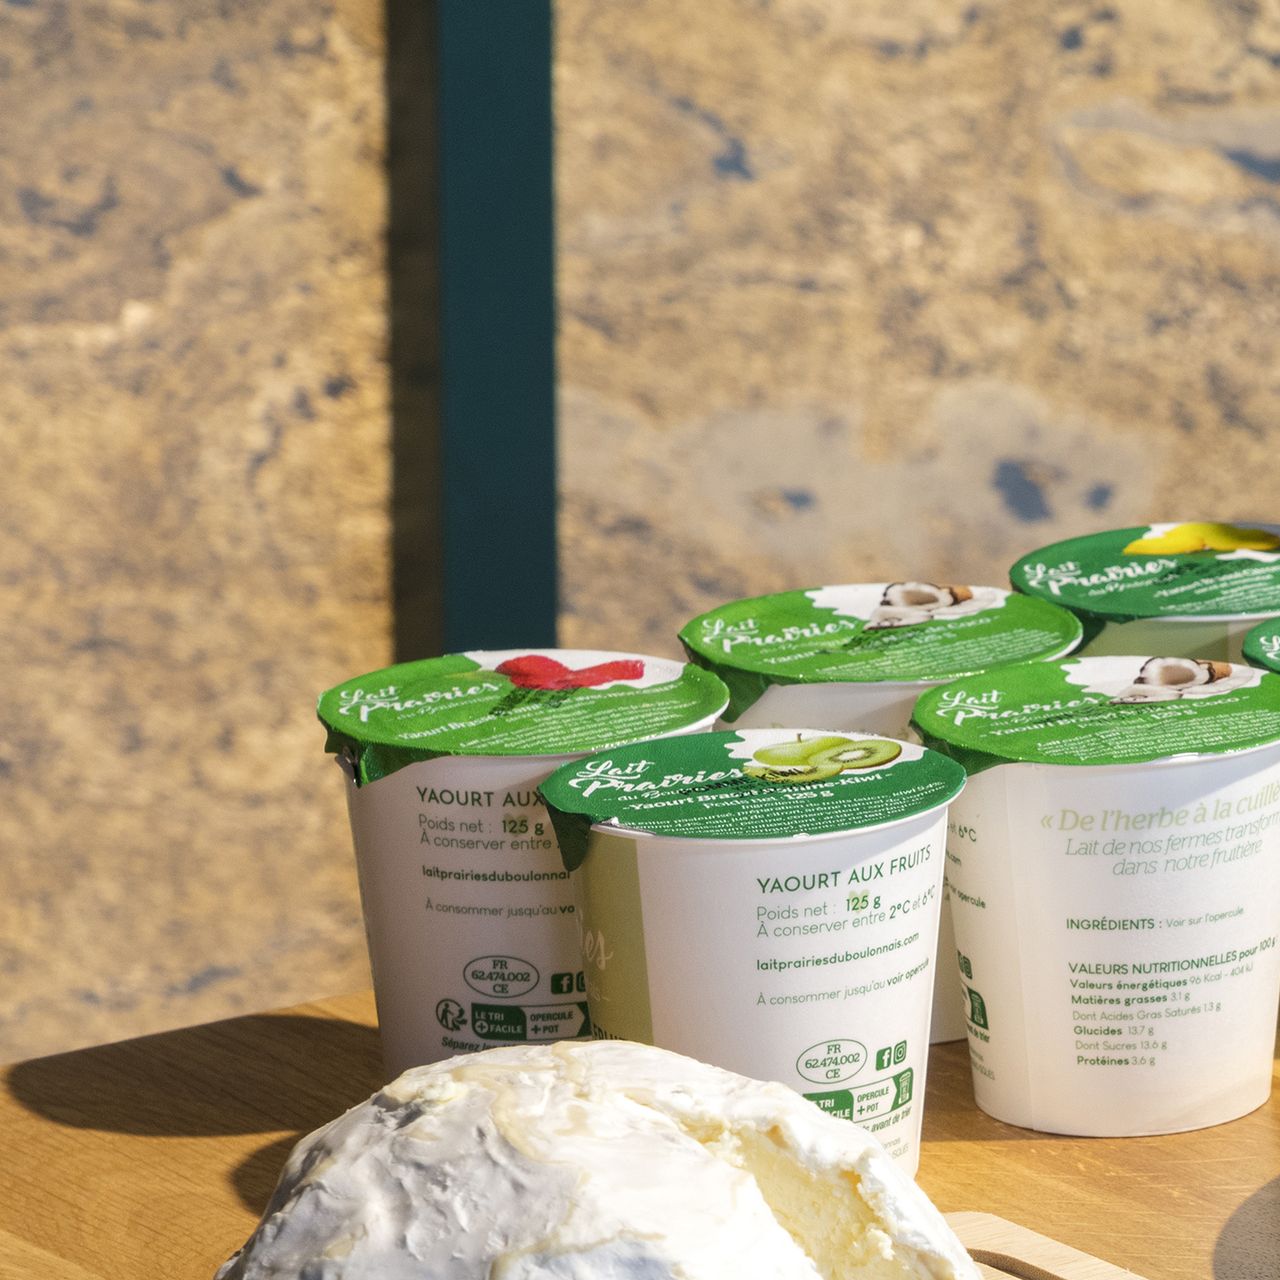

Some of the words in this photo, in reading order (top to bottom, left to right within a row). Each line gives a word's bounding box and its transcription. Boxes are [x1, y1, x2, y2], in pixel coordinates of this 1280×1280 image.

[937, 688, 1008, 710] Lait
[578, 759, 655, 779] Lait
[569, 766, 746, 798] Prairies
[416, 786, 494, 808] YAOURT
[502, 791, 545, 808] AUX
[418, 813, 456, 832] Poids
[460, 819, 484, 833] net
[502, 819, 530, 835] 125
[535, 822, 545, 837] g
[1058, 809, 1095, 832] De
[1193, 803, 1208, 824] à
[1212, 798, 1232, 821] la
[420, 828, 431, 846] À
[434, 836, 505, 851] conserver
[510, 837, 552, 851] entre
[1065, 837, 1100, 856] Lait
[1102, 838, 1125, 856] de
[1129, 838, 1162, 854] nos
[1162, 827, 1222, 856] fermes
[756, 870, 842, 894] YAOURT
[847, 861, 885, 885] AUX
[889, 843, 932, 876] FRUITS
[1112, 858, 1158, 877] dans
[1163, 851, 1209, 873] notre
[424, 896, 434, 912] À
[435, 903, 504, 917] consommer
[756, 904, 799, 921] Poids
[803, 901, 828, 917] net
[845, 894, 869, 912] 125
[872, 895, 882, 910] g
[756, 920, 769, 939] À
[772, 918, 849, 939] conserver
[852, 910, 886, 929] entre
[1065, 915, 1155, 931] INGRÉDIENTS
[756, 931, 920, 973] laitprairiesduboulonnais.com
[1068, 960, 1129, 976] VALEURS
[1131, 949, 1238, 975] NUTRITIONNELLES
[1238, 945, 1259, 962] pour
[492, 959, 509, 970] FR
[492, 984, 509, 994] CE
[756, 991, 767, 1007] À
[769, 989, 842, 1006] consommer
[886, 972, 905, 988] voir
[1069, 978, 1114, 991] Valeurs
[1116, 979, 1188, 993] énergétiques
[1071, 994, 1121, 1006] Matières
[1123, 993, 1168, 1008] grasses
[530, 1011, 574, 1022] OPERCULE
[490, 1023, 523, 1034] FACILE
[543, 1024, 560, 1034] POT
[1073, 1025, 1123, 1037] Glucides
[826, 1043, 842, 1055] FR
[805, 1052, 861, 1070] 62.474.002
[1076, 1054, 1130, 1067] Protéines
[825, 1068, 841, 1080] CE
[857, 1085, 890, 1103] OPERCULE
[866, 1102, 879, 1113] POT
